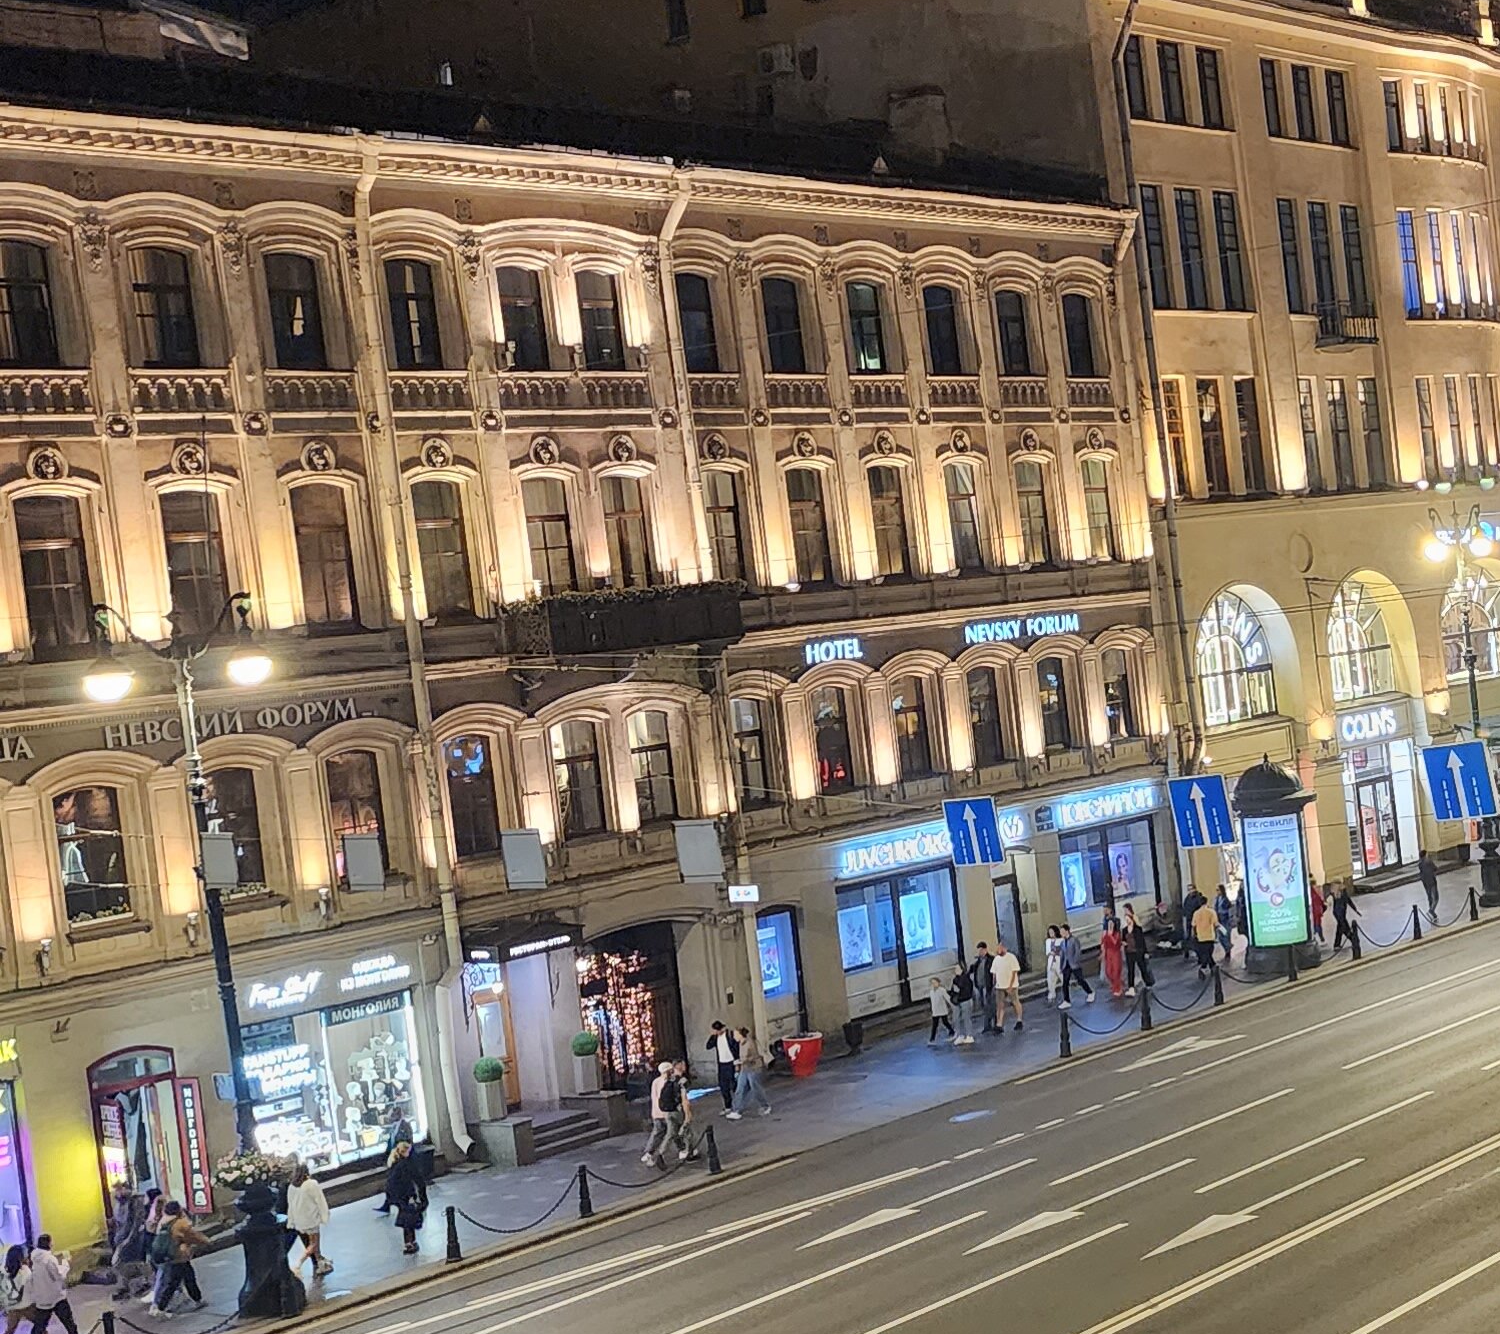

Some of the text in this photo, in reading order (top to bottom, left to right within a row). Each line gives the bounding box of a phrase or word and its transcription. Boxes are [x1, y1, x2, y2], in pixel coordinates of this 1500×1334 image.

[964, 613, 1080, 645] NEVSKY FORUM
[805, 637, 863, 665] HOTEL
[256, 697, 358, 729] ФОРУМ
[1247, 817, 1294, 829] ВКУСВИЛЛ
[331, 996, 400, 1024] МОНГОЛИЯ
